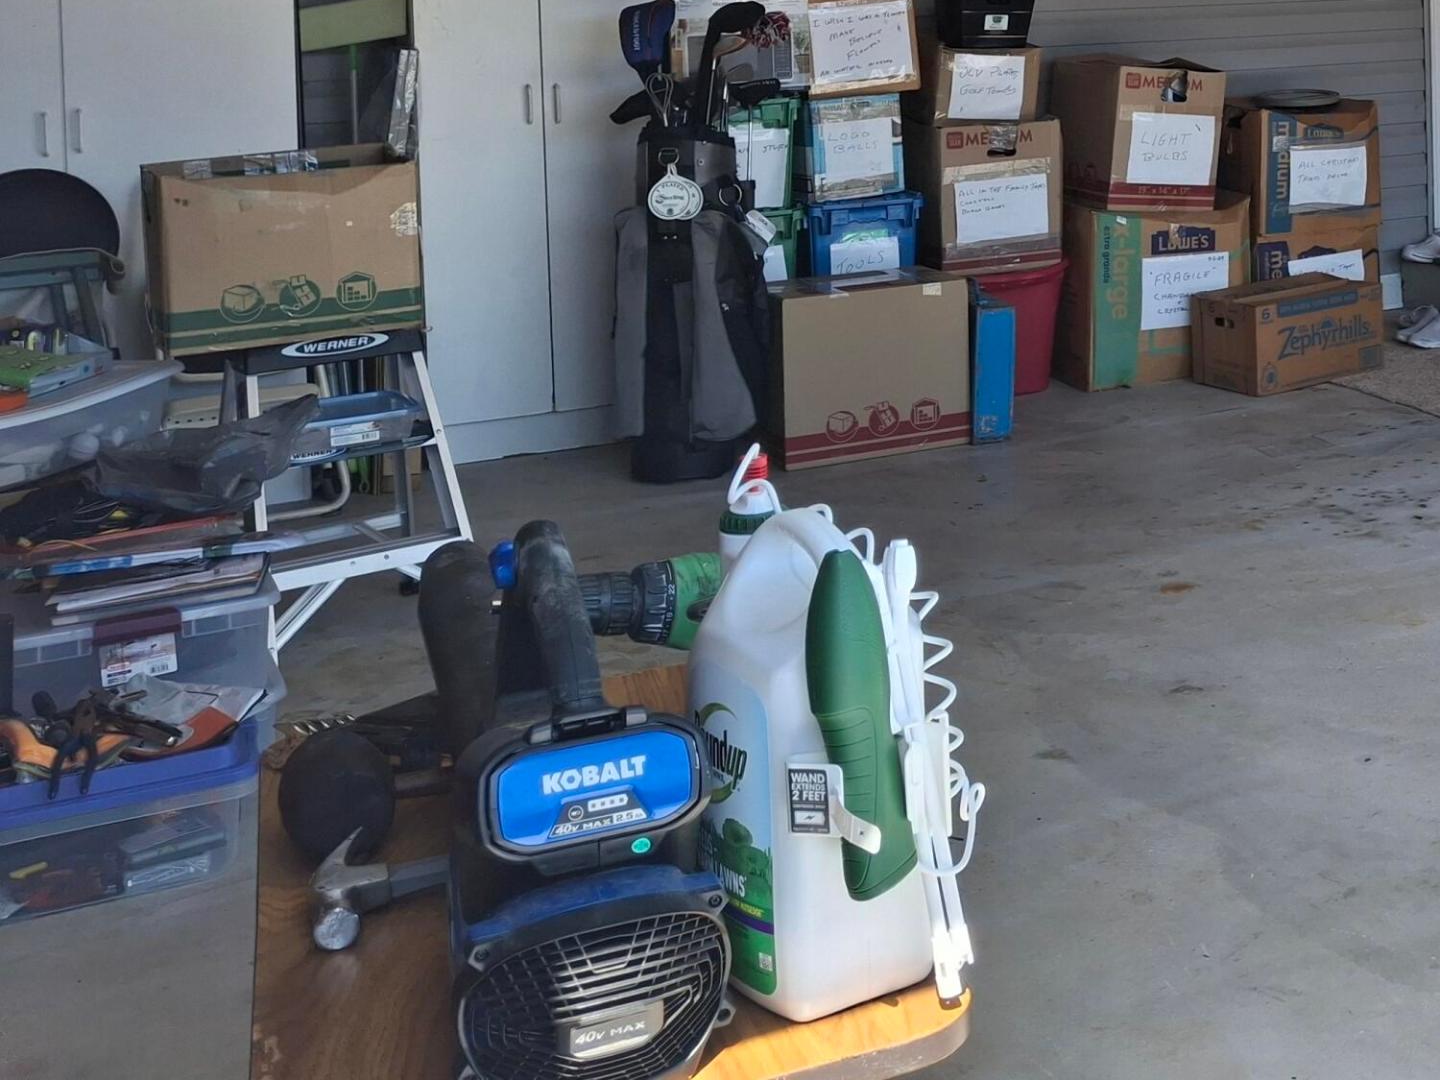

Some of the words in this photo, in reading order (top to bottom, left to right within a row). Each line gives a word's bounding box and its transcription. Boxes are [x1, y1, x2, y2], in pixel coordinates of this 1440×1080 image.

[1142, 76, 1203, 91] MEM
[965, 129, 1033, 146] MEM
[1140, 132, 1192, 147] LIGHT
[1276, 121, 1289, 200] mdium
[303, 336, 370, 353] WERNER
[1276, 314, 1370, 361] Zephyrhills
[542, 755, 646, 795] KOBALT
[790, 772, 825, 784] WAND
[791, 783, 825, 791] EXTENDS
[791, 791, 800, 801] 2
[803, 791, 826, 802] FEET
[583, 817, 612, 831] MAX
[609, 1020, 646, 1036] MAX
